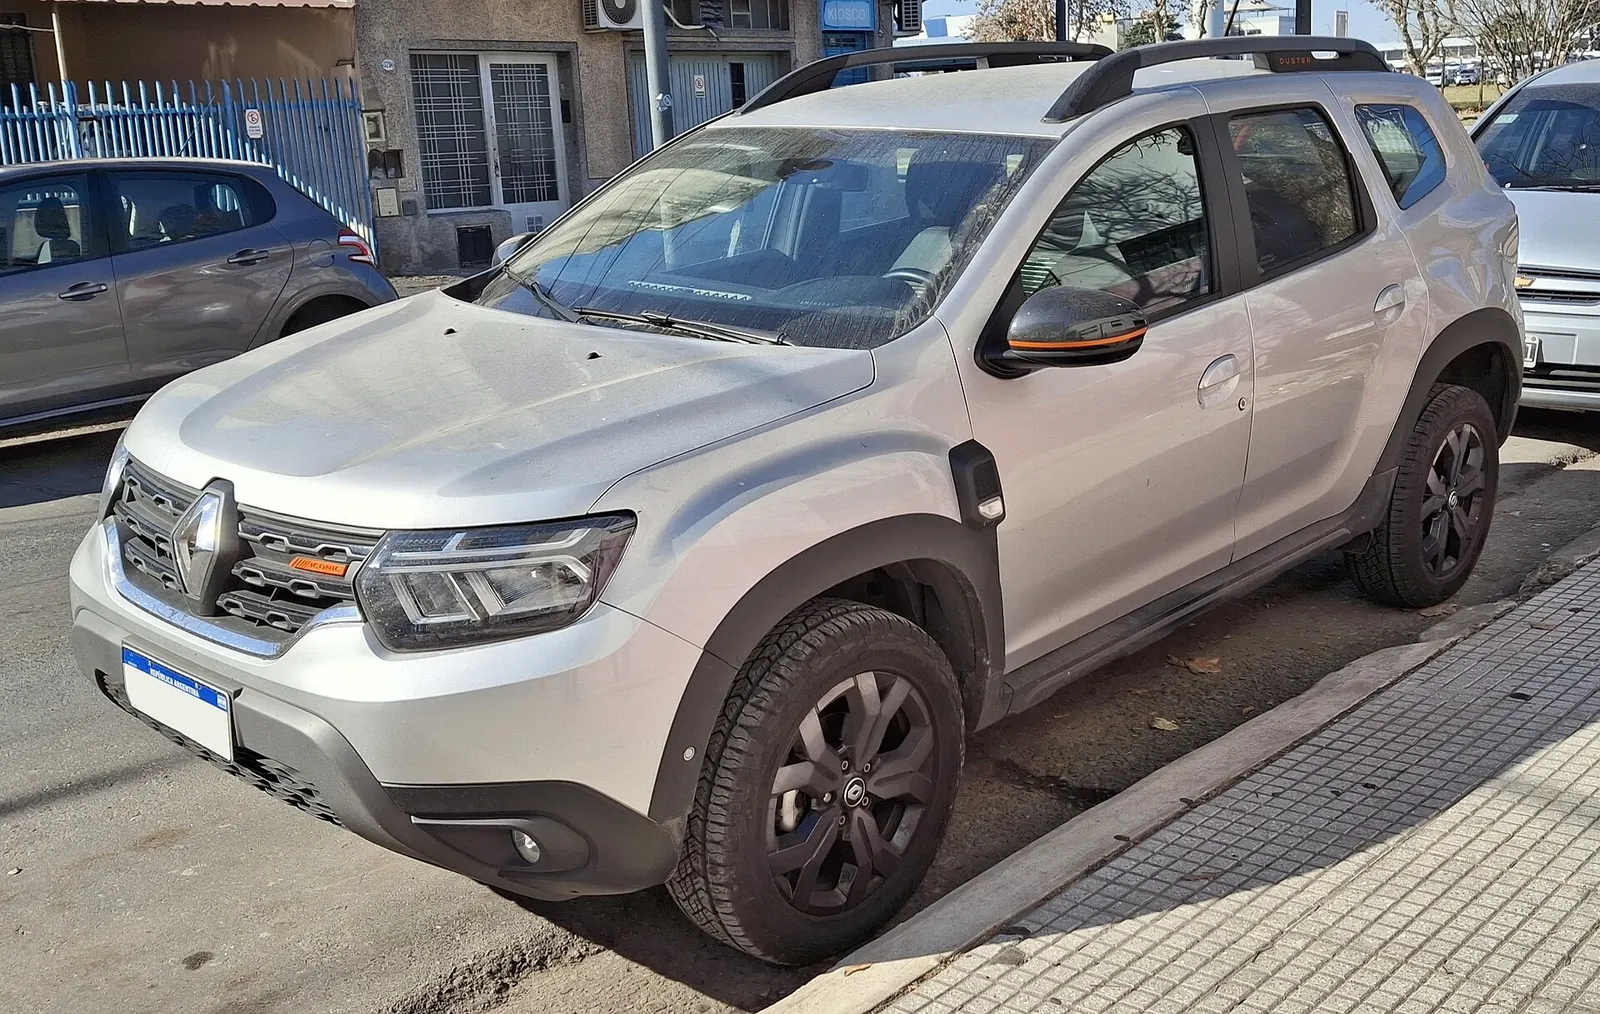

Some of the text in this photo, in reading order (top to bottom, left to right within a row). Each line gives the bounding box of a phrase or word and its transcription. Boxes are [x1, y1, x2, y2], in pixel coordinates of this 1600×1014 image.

[827, 8, 866, 20] KIOSCO
[1279, 57, 1311, 65] DUSTER
[310, 562, 341, 572] ICONIC
[173, 680, 200, 698] ARGENTINA
